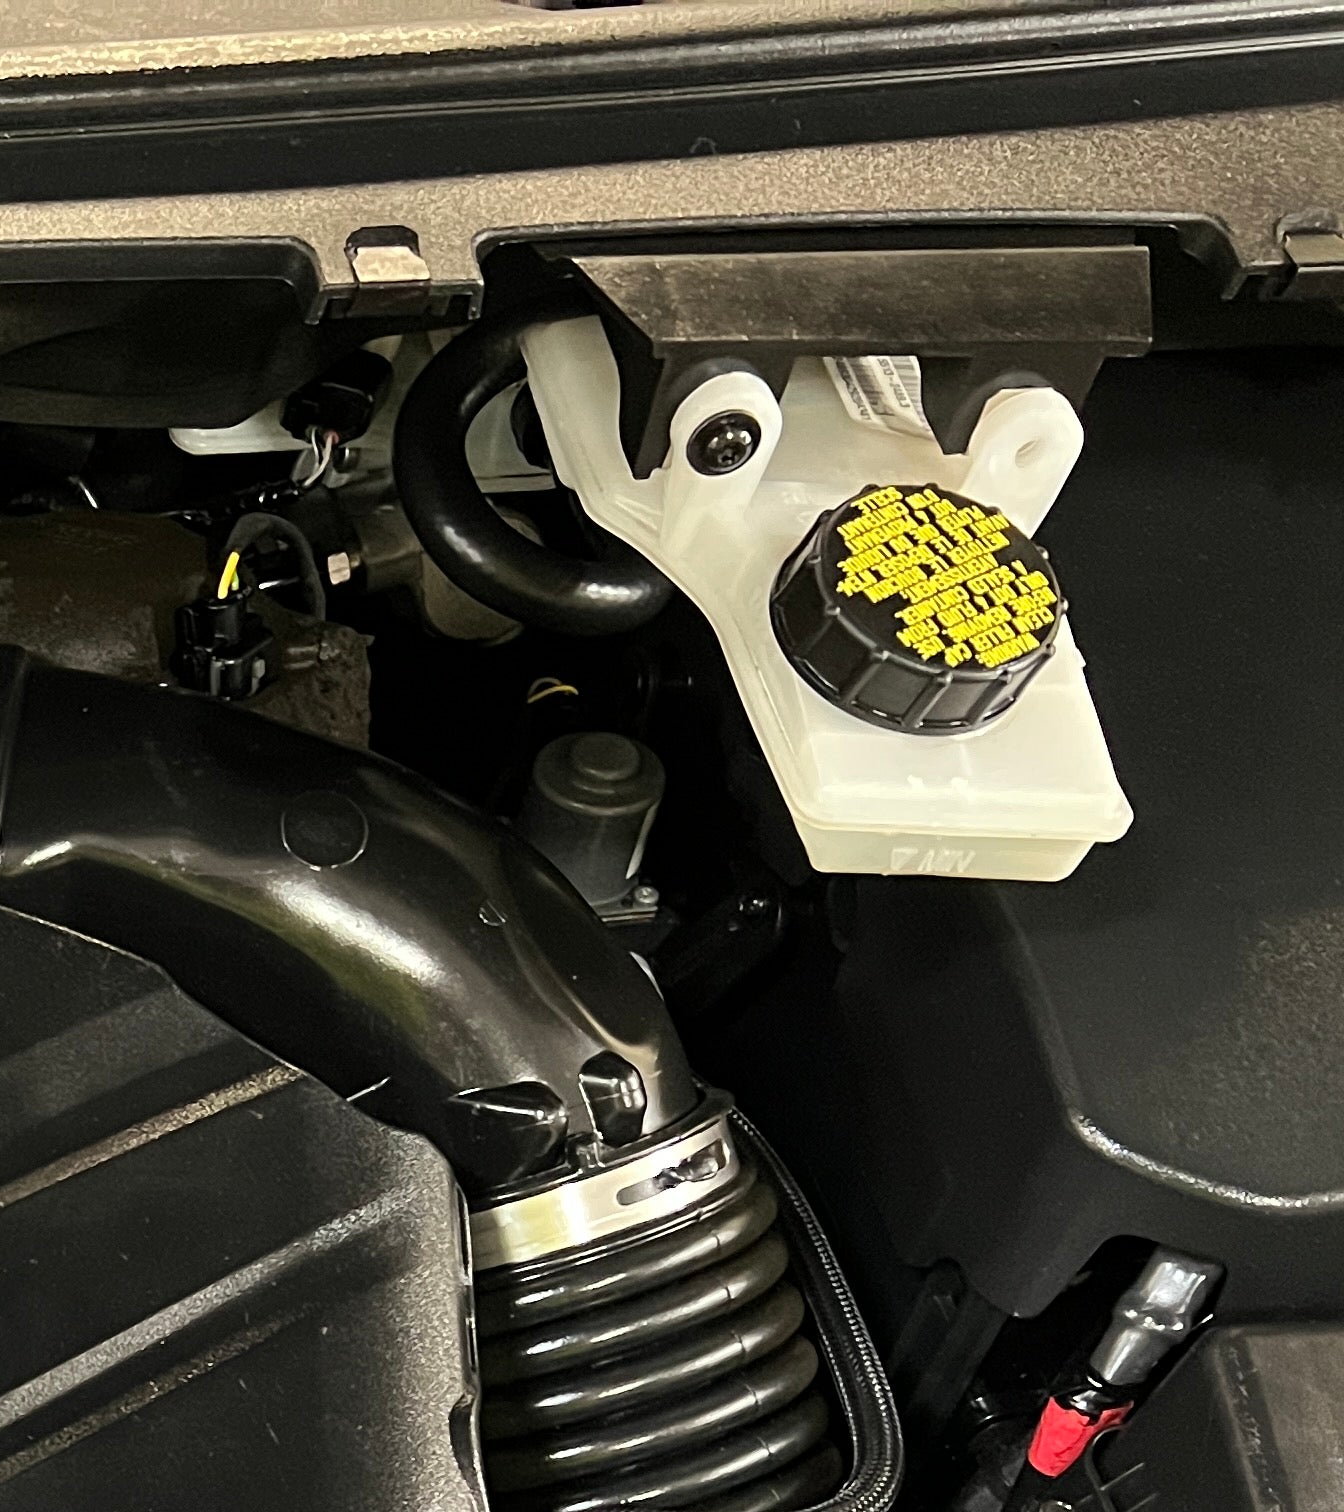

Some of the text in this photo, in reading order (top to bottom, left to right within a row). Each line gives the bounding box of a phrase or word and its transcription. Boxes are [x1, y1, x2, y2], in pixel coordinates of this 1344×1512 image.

[836, 502, 908, 540] CONTENANT
[926, 499, 956, 520] DOT
[843, 515, 917, 555] PROVENANT
[907, 524, 939, 546] QUE
[947, 528, 971, 548] DE
[968, 512, 1008, 538] AVANT
[887, 534, 911, 554] DU
[928, 536, 952, 554] LE
[925, 557, 948, 574] LE
[861, 566, 926, 603] BOUCHON
[895, 560, 1026, 625] A SEALED CONTAINER.
[986, 584, 1014, 607] DOT
[1012, 571, 1048, 596] ONLY
[910, 586, 1056, 660] BEFORE REMOVING. USE
[935, 600, 977, 630] FLUID
[894, 617, 937, 647] FROM
[942, 606, 1053, 667] CLEAN FILLER CAP
[974, 631, 1039, 668] WARNING:
